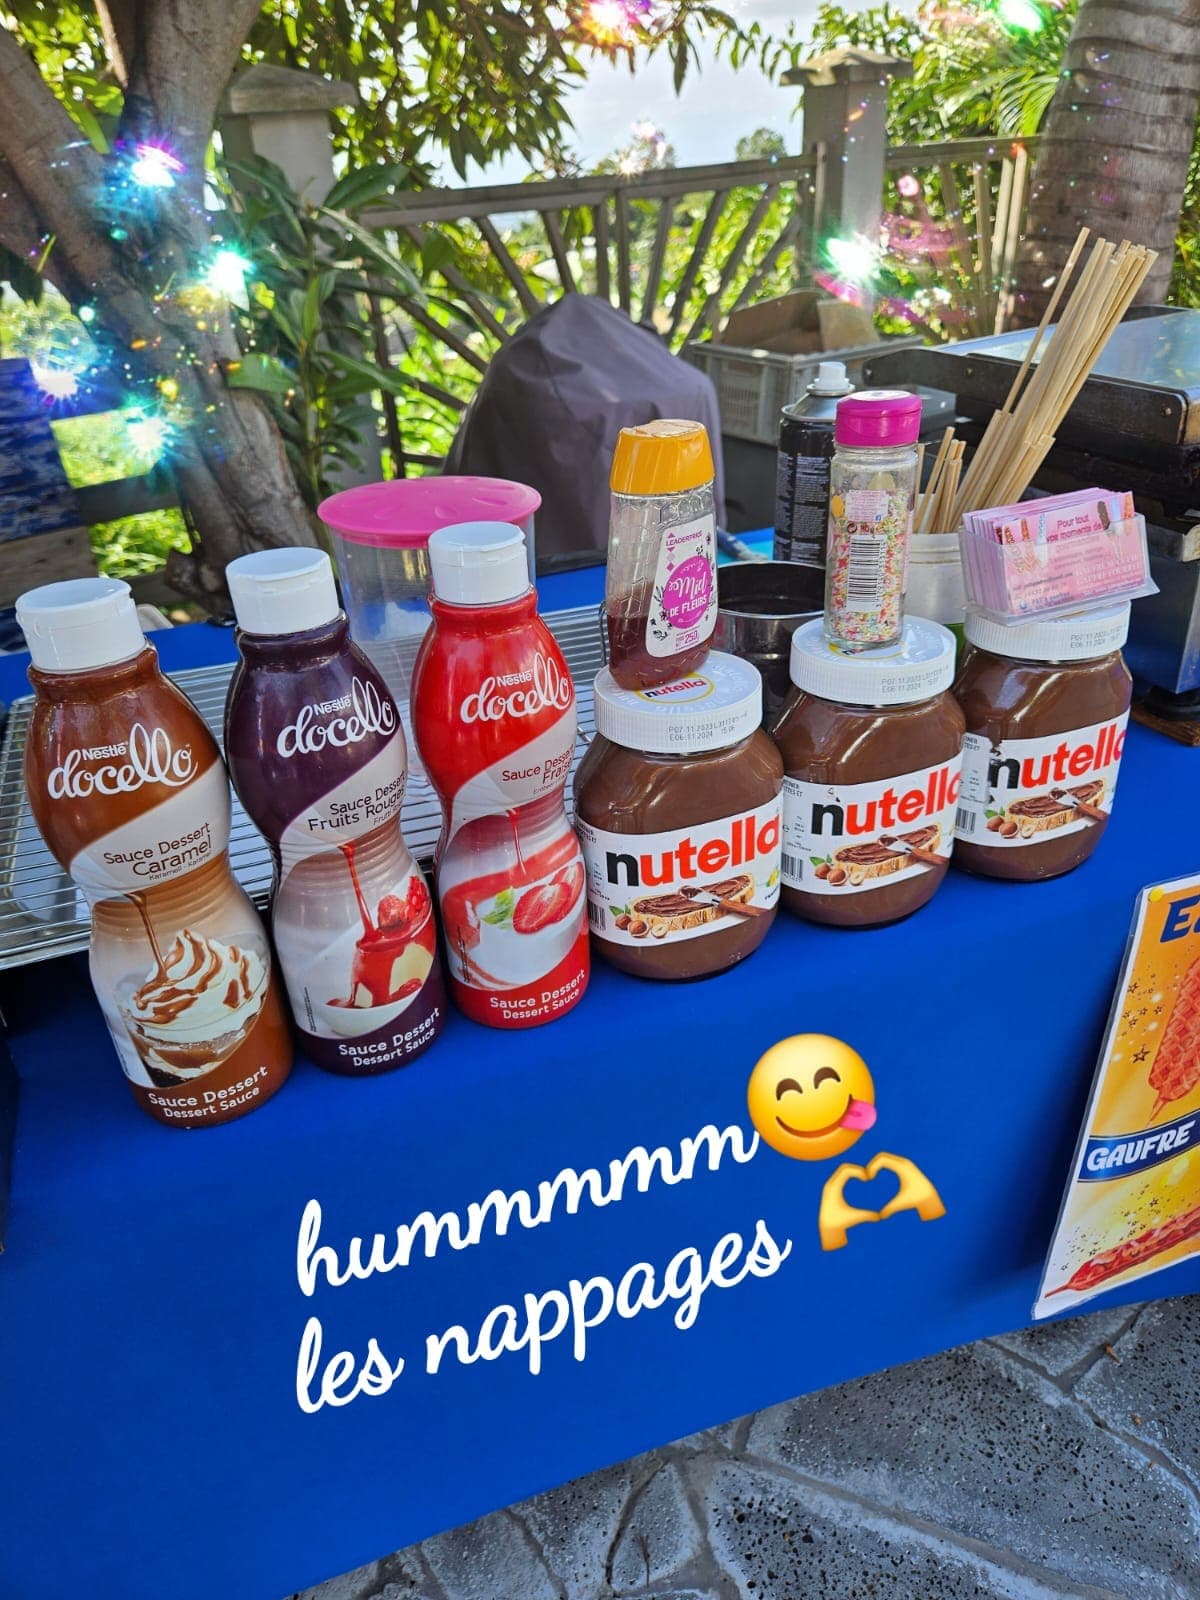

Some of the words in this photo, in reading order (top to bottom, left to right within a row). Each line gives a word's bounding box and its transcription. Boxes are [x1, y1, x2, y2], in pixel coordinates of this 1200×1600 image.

[460, 652, 571, 724] docello
[645, 678, 707, 698] nutella
[276, 676, 396, 758] docello
[47, 722, 198, 800] docello
[502, 766, 541, 781] Sauce
[308, 813, 360, 831] Fruits
[330, 795, 371, 815] Sauce
[104, 849, 153, 864] Sauce
[158, 822, 210, 855] Dessert
[132, 834, 211, 876] Caramel
[606, 814, 779, 887] nutella
[1160, 893, 1200, 943] E
[490, 996, 536, 1009] Sauce
[541, 969, 585, 1004] Dessert
[503, 1005, 549, 1020] Dessert
[552, 987, 580, 1011] Sauce
[338, 1040, 388, 1056] Sauce
[393, 1007, 440, 1047] Dessert
[353, 1047, 402, 1067] Dessert
[405, 1026, 435, 1053] Sauce
[148, 1092, 197, 1108] Sauce
[203, 1066, 268, 1101] Dessert
[163, 1102, 217, 1118] Dessert
[221, 1086, 260, 1111] Sauce
[1086, 1120, 1196, 1172] GAUFRE
